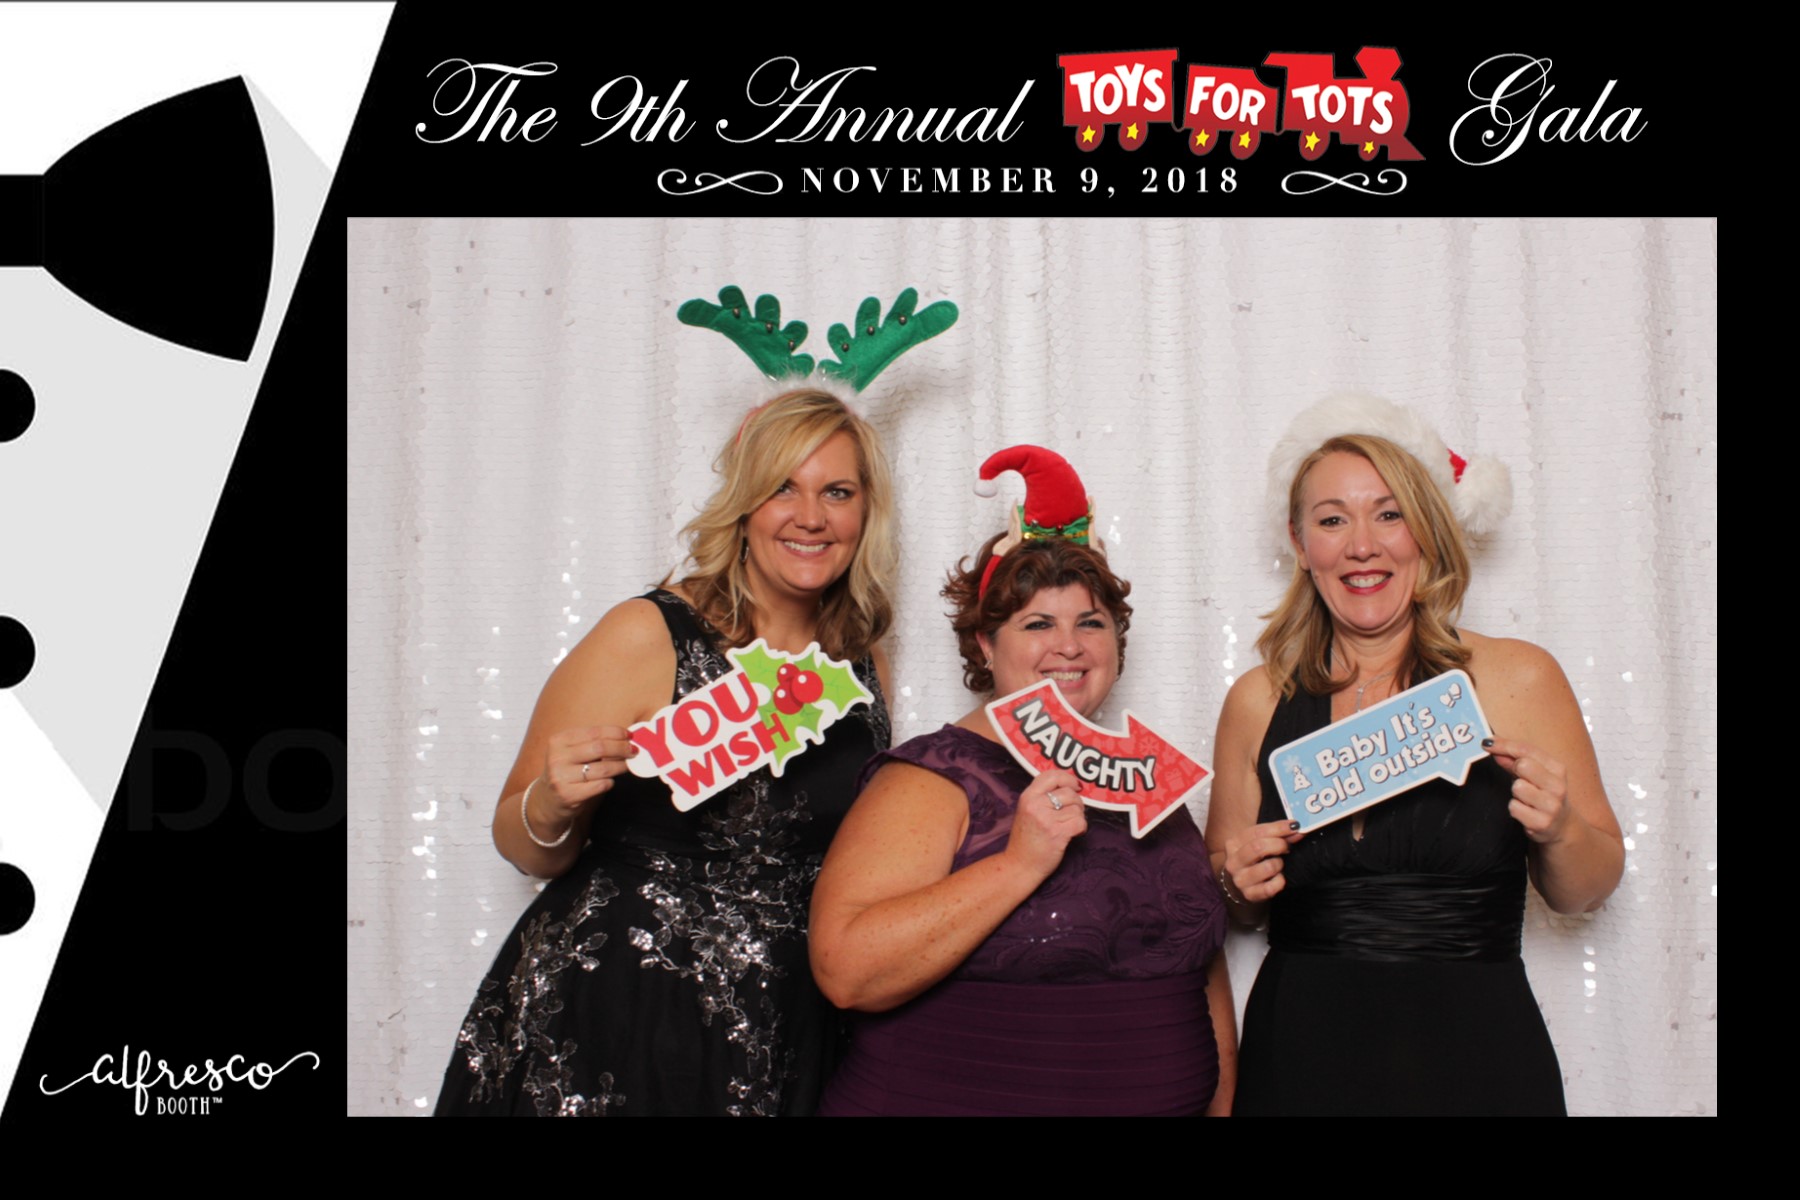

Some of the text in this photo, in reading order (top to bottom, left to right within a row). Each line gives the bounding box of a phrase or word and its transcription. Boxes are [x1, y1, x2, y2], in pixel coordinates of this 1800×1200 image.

[630, 672, 759, 769] YOU
[666, 712, 790, 797] WISH
[1013, 697, 1156, 792] NAUGHTY
[1315, 702, 1436, 778] Baby It's
[1304, 723, 1474, 814] cold outside
